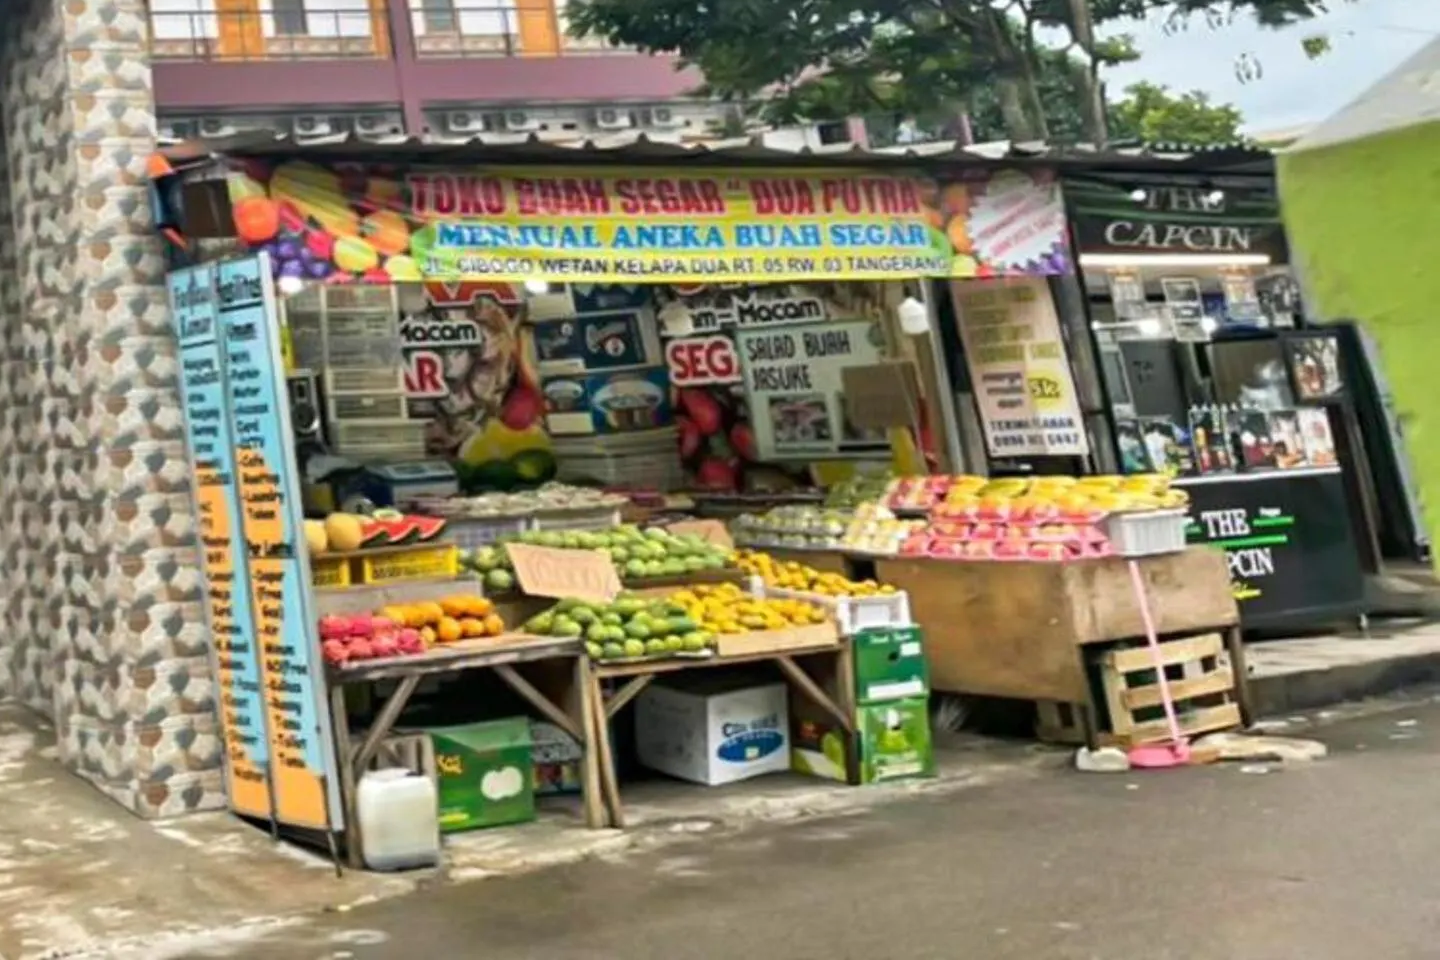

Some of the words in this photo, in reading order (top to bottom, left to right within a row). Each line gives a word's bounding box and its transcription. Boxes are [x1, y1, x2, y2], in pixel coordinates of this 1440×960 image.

[409, 175, 505, 215] TOKO
[513, 177, 610, 215] BUAH
[615, 177, 725, 214] SEGAR
[749, 177, 816, 215] DUA
[821, 176, 922, 214] PUTRA
[437, 222, 603, 248] MENJUAL
[611, 224, 725, 248] ANEKA
[733, 223, 823, 248] BUAH
[829, 222, 927, 247] SEGAR
[1104, 220, 1252, 251] CAPCIN
[538, 257, 608, 274] WETAN
[613, 257, 687, 275] KELAPA
[690, 258, 730, 274] DUA
[847, 254, 949, 272] TANGERANG
[669, 340, 741, 381] SEG
[745, 333, 797, 363] SALAD
[802, 329, 852, 358] BUAH
[1200, 508, 1251, 538] THE
[1224, 547, 1275, 579] PCIN
